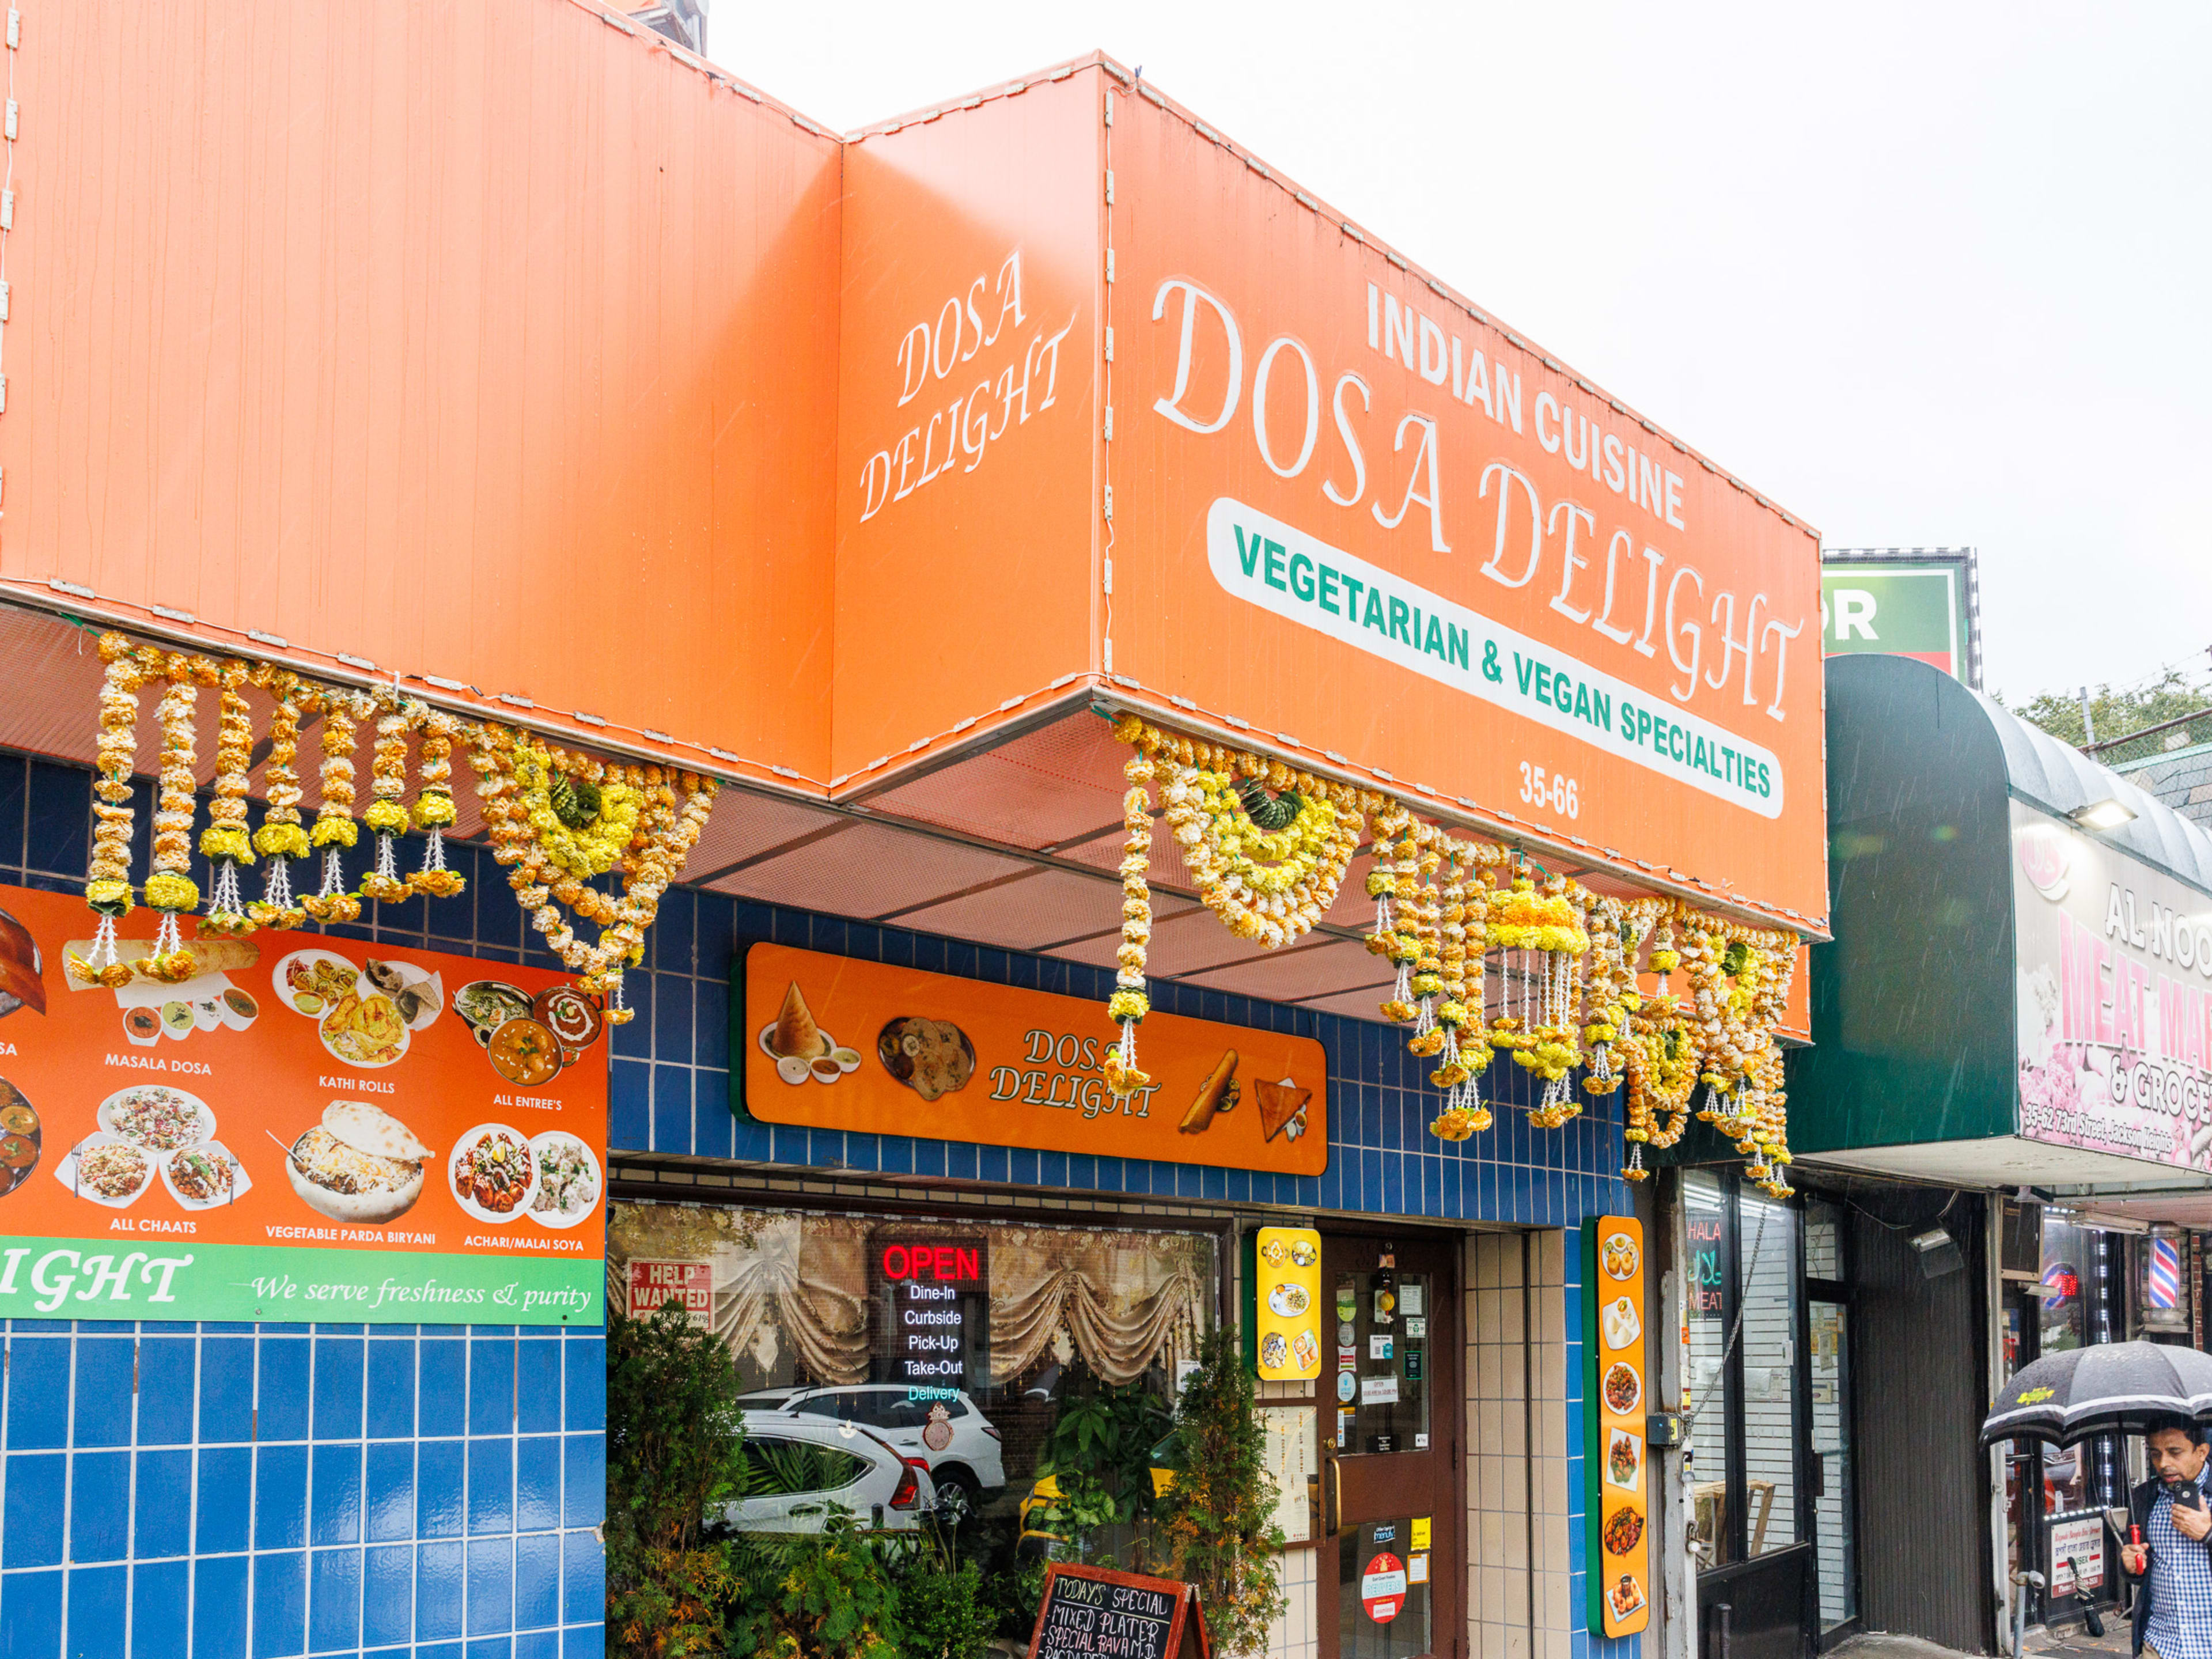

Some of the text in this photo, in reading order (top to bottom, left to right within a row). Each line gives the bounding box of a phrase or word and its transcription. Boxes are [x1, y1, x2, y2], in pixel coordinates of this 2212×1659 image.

[897, 250, 1025, 408] DOSA
[860, 312, 1075, 523] DELIGHT
[1367, 281, 1685, 532] INDIAN CUISINE
[1152, 279, 1804, 722] DOSA DELIGHT
[1822, 589, 1879, 640] R
[1233, 524, 1771, 800] VEGETARIAN & VEGAN SPECIALTIES
[1519, 761, 1580, 820] 35-66
[2105, 882, 2146, 949] AL
[2058, 906, 2149, 1054] MEAT
[105, 1054, 212, 1075] MASALA DOSA
[2111, 1054, 2127, 1103] &
[319, 1075, 395, 1094] KATHI ROLLS
[494, 1094, 562, 1111] ALL ENTREE'S
[2025, 1103, 2173, 1154] 35-62 73rd Street, Jackson Heights
[109, 1218, 197, 1234] ALL CHAATS
[266, 1225, 435, 1245] VEGETABLE PARDA BIRYANI
[464, 1235, 584, 1252] ACHARI/MALAI SOYA
[650, 1264, 695, 1285] HELP
[884, 1245, 978, 1280] OPEN
[251, 1274, 592, 1313] We serve freshness & purity
[634, 1287, 708, 1308] WANTED
[911, 1285, 955, 1300] Dine-In
[1689, 1291, 1722, 1310] MEAT
[905, 1310, 961, 1324] Curbside
[909, 1335, 958, 1353] Pick-Up
[904, 1360, 963, 1375] Take-Out
[908, 1386, 960, 1402] Delivery
[1055, 1578, 1168, 1615] TODAY'S SPECIAL
[1052, 1605, 1159, 1643] MIXED PLATER
[1047, 1625, 1094, 1652] SPECIAL
[1097, 1635, 1128, 1658] RAVA
